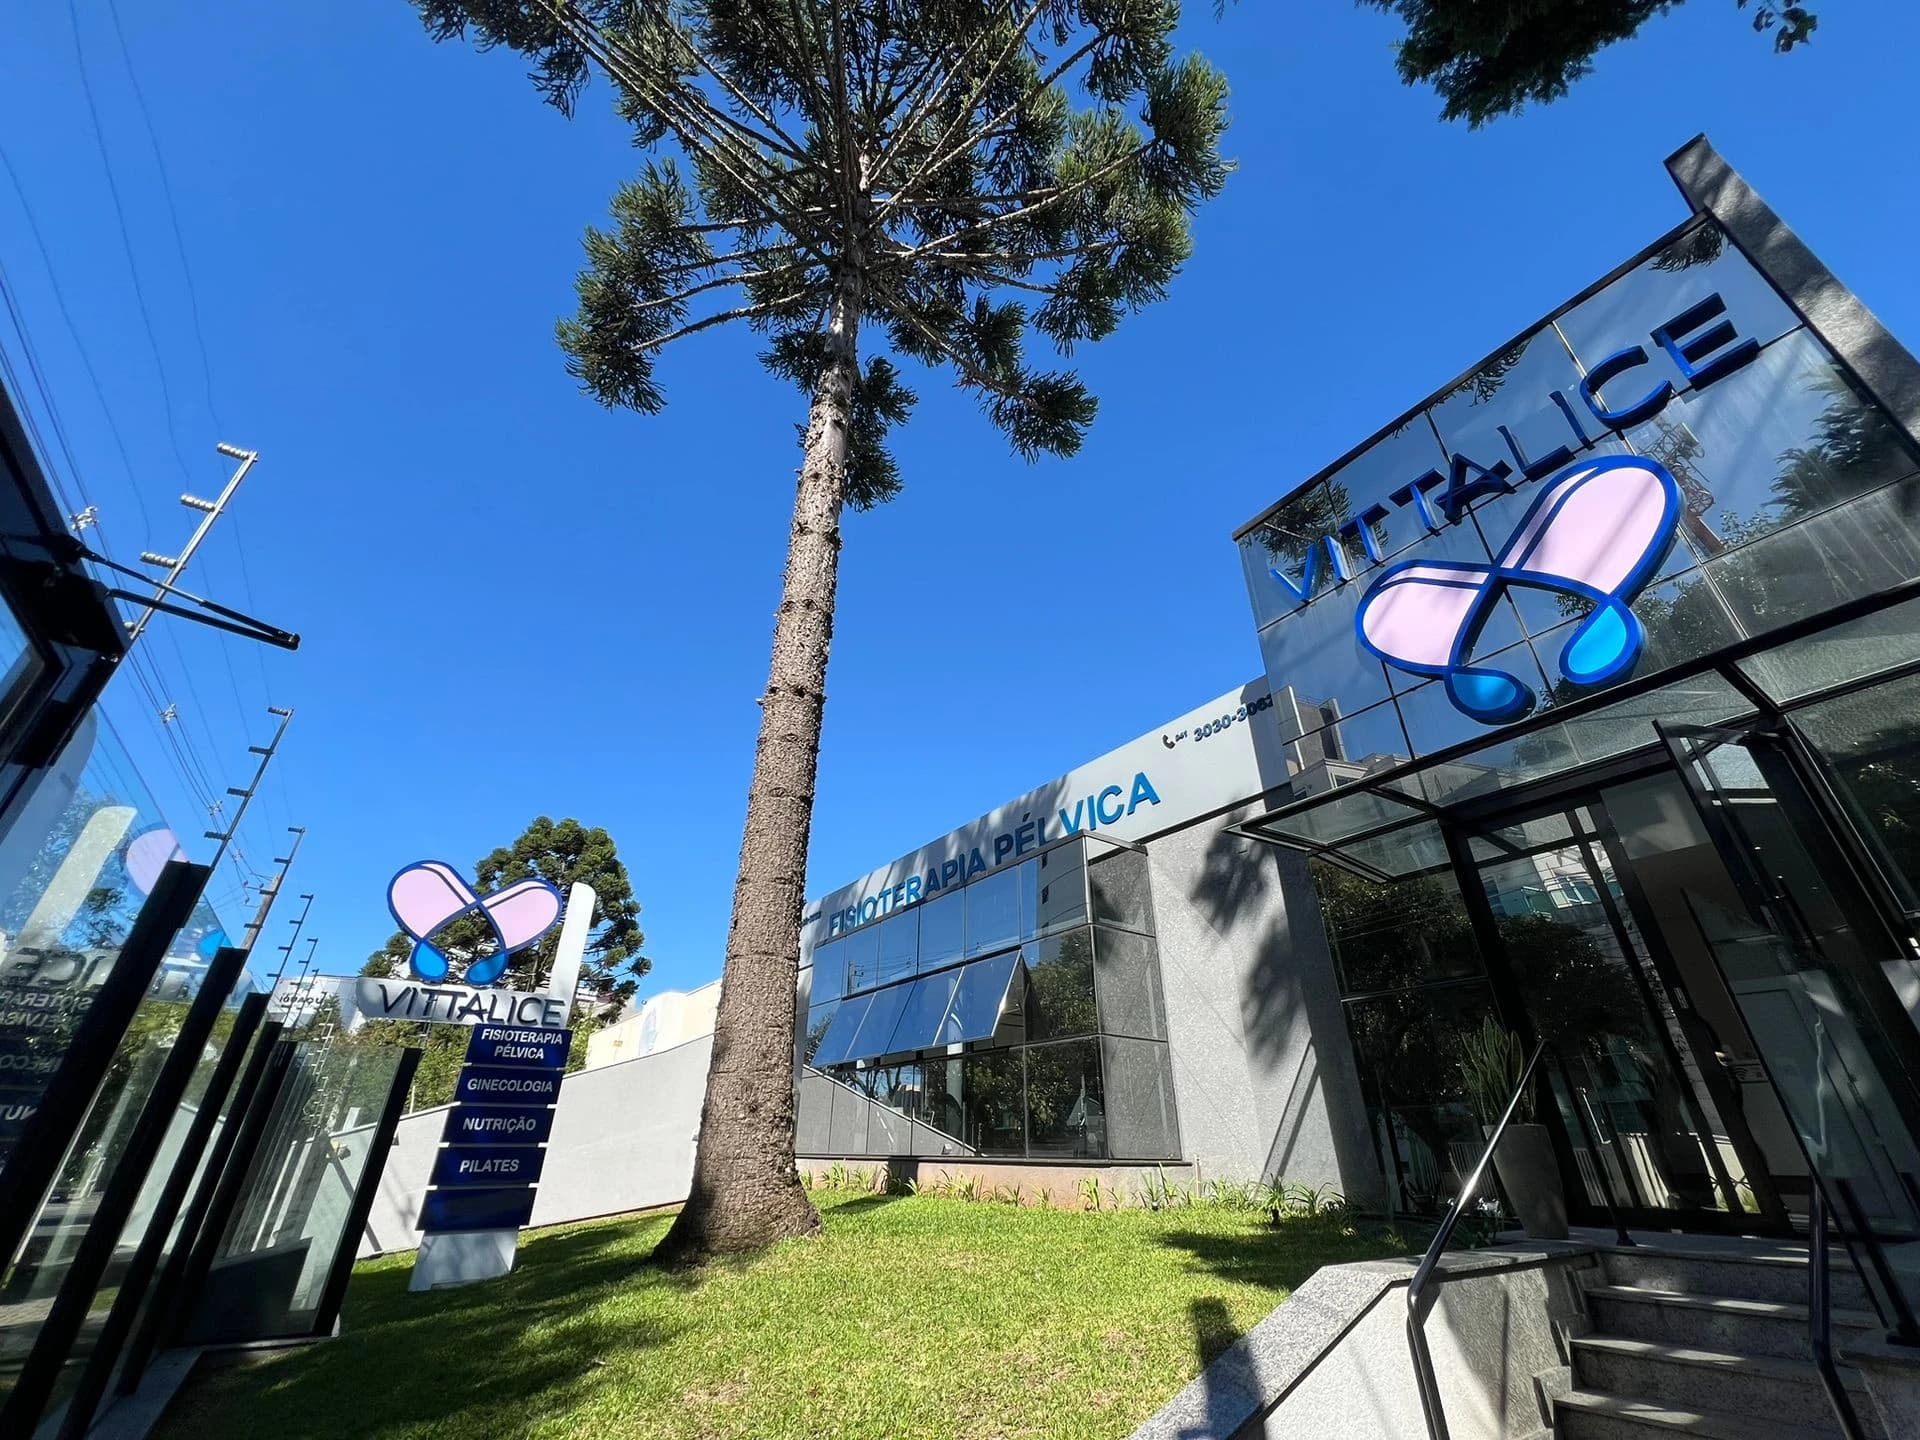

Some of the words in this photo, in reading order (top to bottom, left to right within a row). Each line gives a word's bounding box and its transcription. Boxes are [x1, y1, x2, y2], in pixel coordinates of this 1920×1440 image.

[1269, 292, 1760, 602] VITTALICE
[829, 848, 986, 936] FISIOTERAPIA
[994, 772, 1161, 865] PÉLVICA
[379, 983, 566, 1028] VITTALICE
[480, 1028, 563, 1046] FISIOTERAPIA
[494, 1043, 545, 1060] PÉLVICA
[466, 1077, 553, 1093] GINECOLOGIA
[462, 1116, 536, 1133] NUTRIÇÃO
[459, 1158, 520, 1174] PILATES
